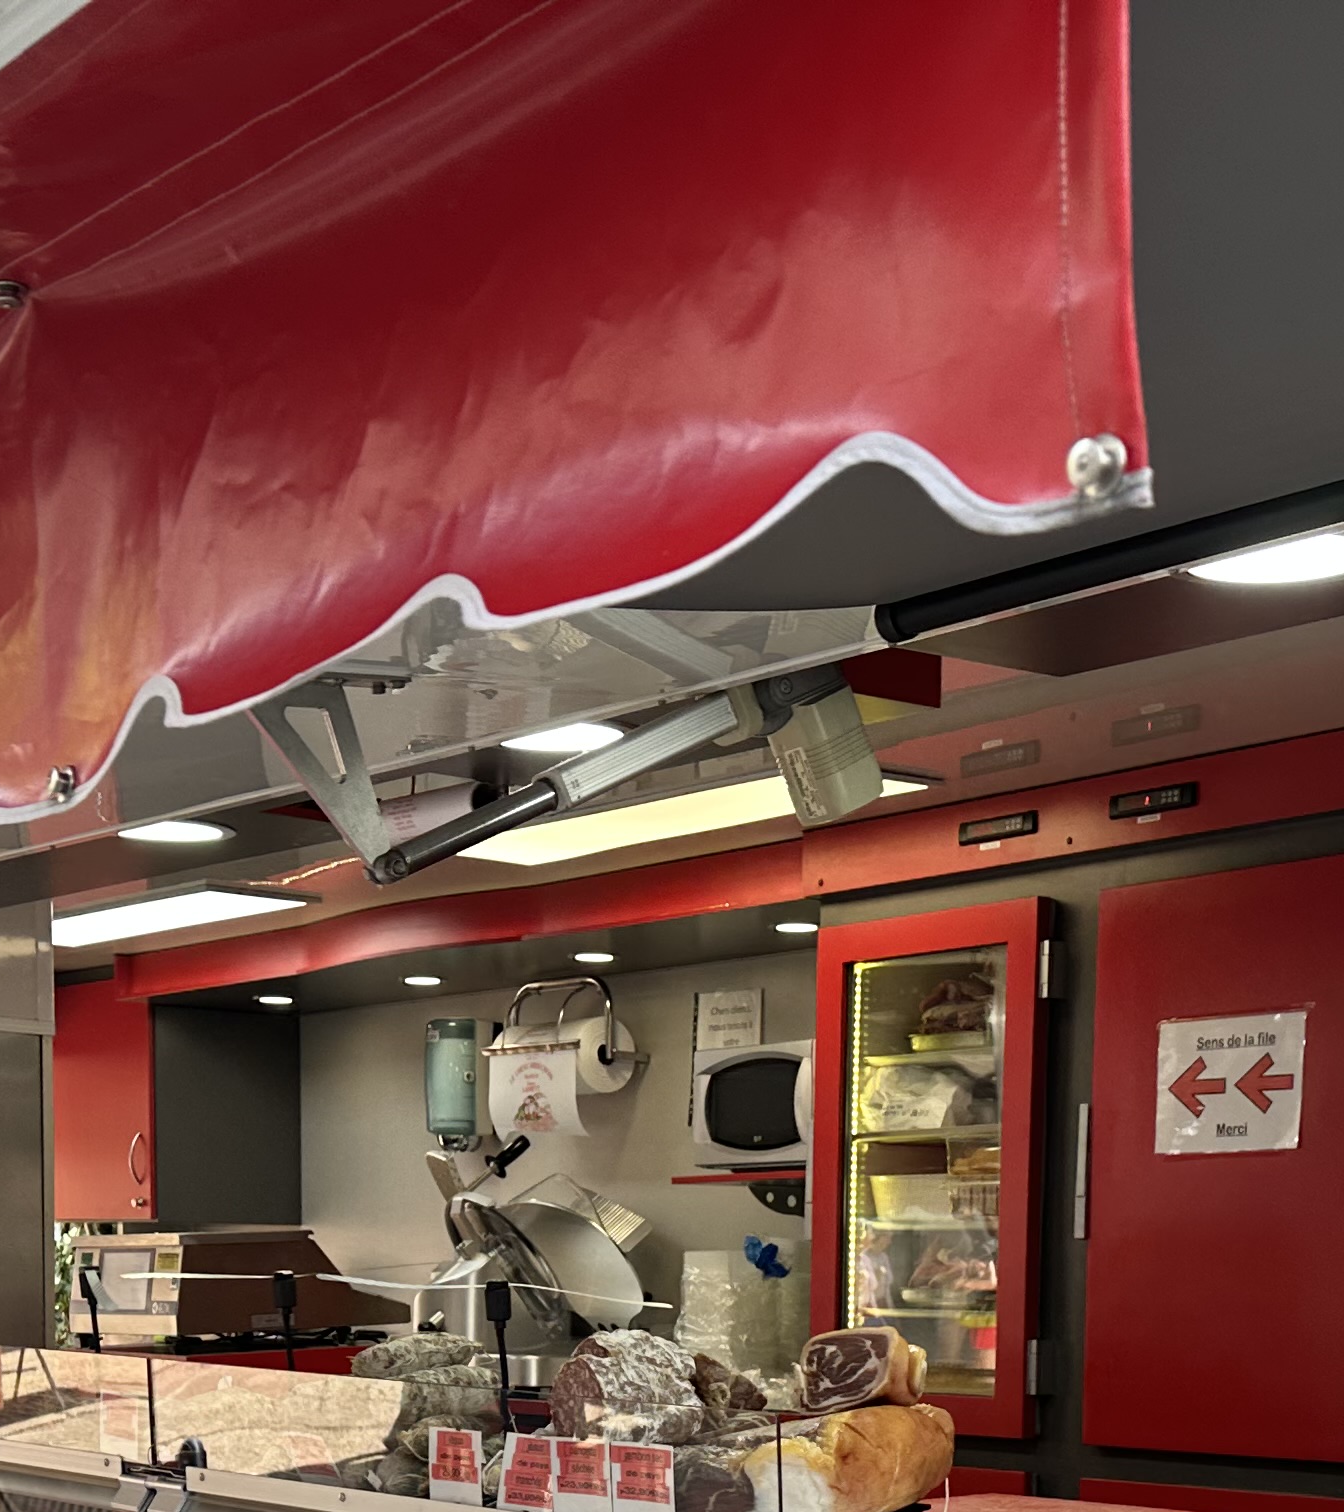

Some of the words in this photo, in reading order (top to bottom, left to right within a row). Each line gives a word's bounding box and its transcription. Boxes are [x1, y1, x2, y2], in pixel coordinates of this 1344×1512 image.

[1196, 1036, 1224, 1050] Sens
[1227, 1033, 1241, 1048] de
[1244, 1033, 1255, 1046] la
[1257, 1032, 1276, 1046] file
[1216, 1122, 1248, 1136] Merci
